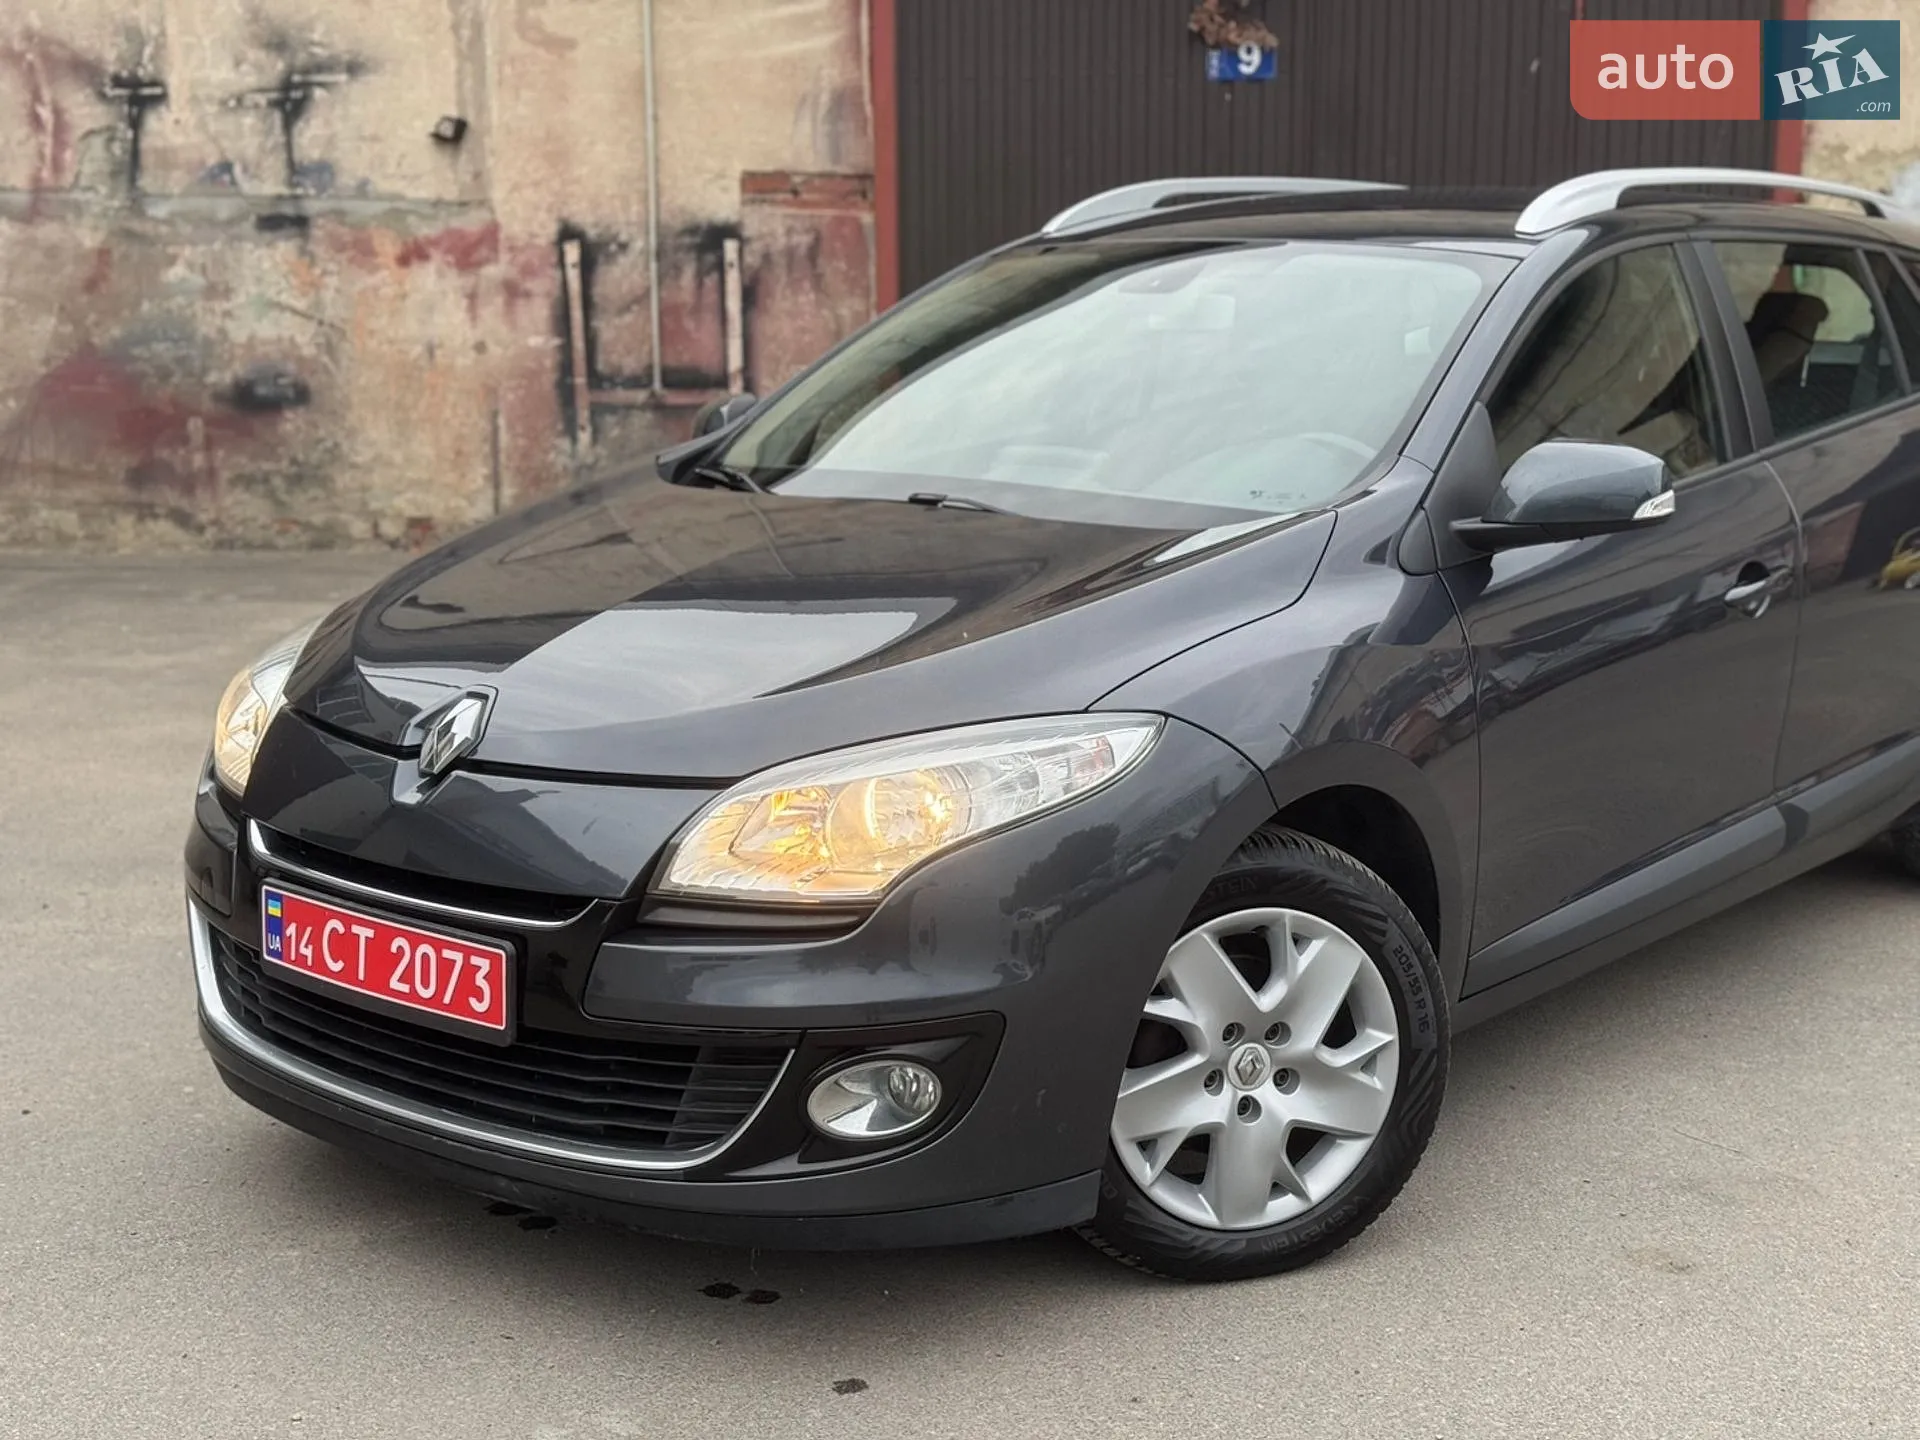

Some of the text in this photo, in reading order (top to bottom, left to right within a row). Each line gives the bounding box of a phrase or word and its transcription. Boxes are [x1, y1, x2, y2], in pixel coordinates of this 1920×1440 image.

[1237, 41, 1262, 75] 9
[267, 932, 282, 952] UA
[389, 936, 492, 1013] 2073
[1392, 944, 1424, 997] 205/55
